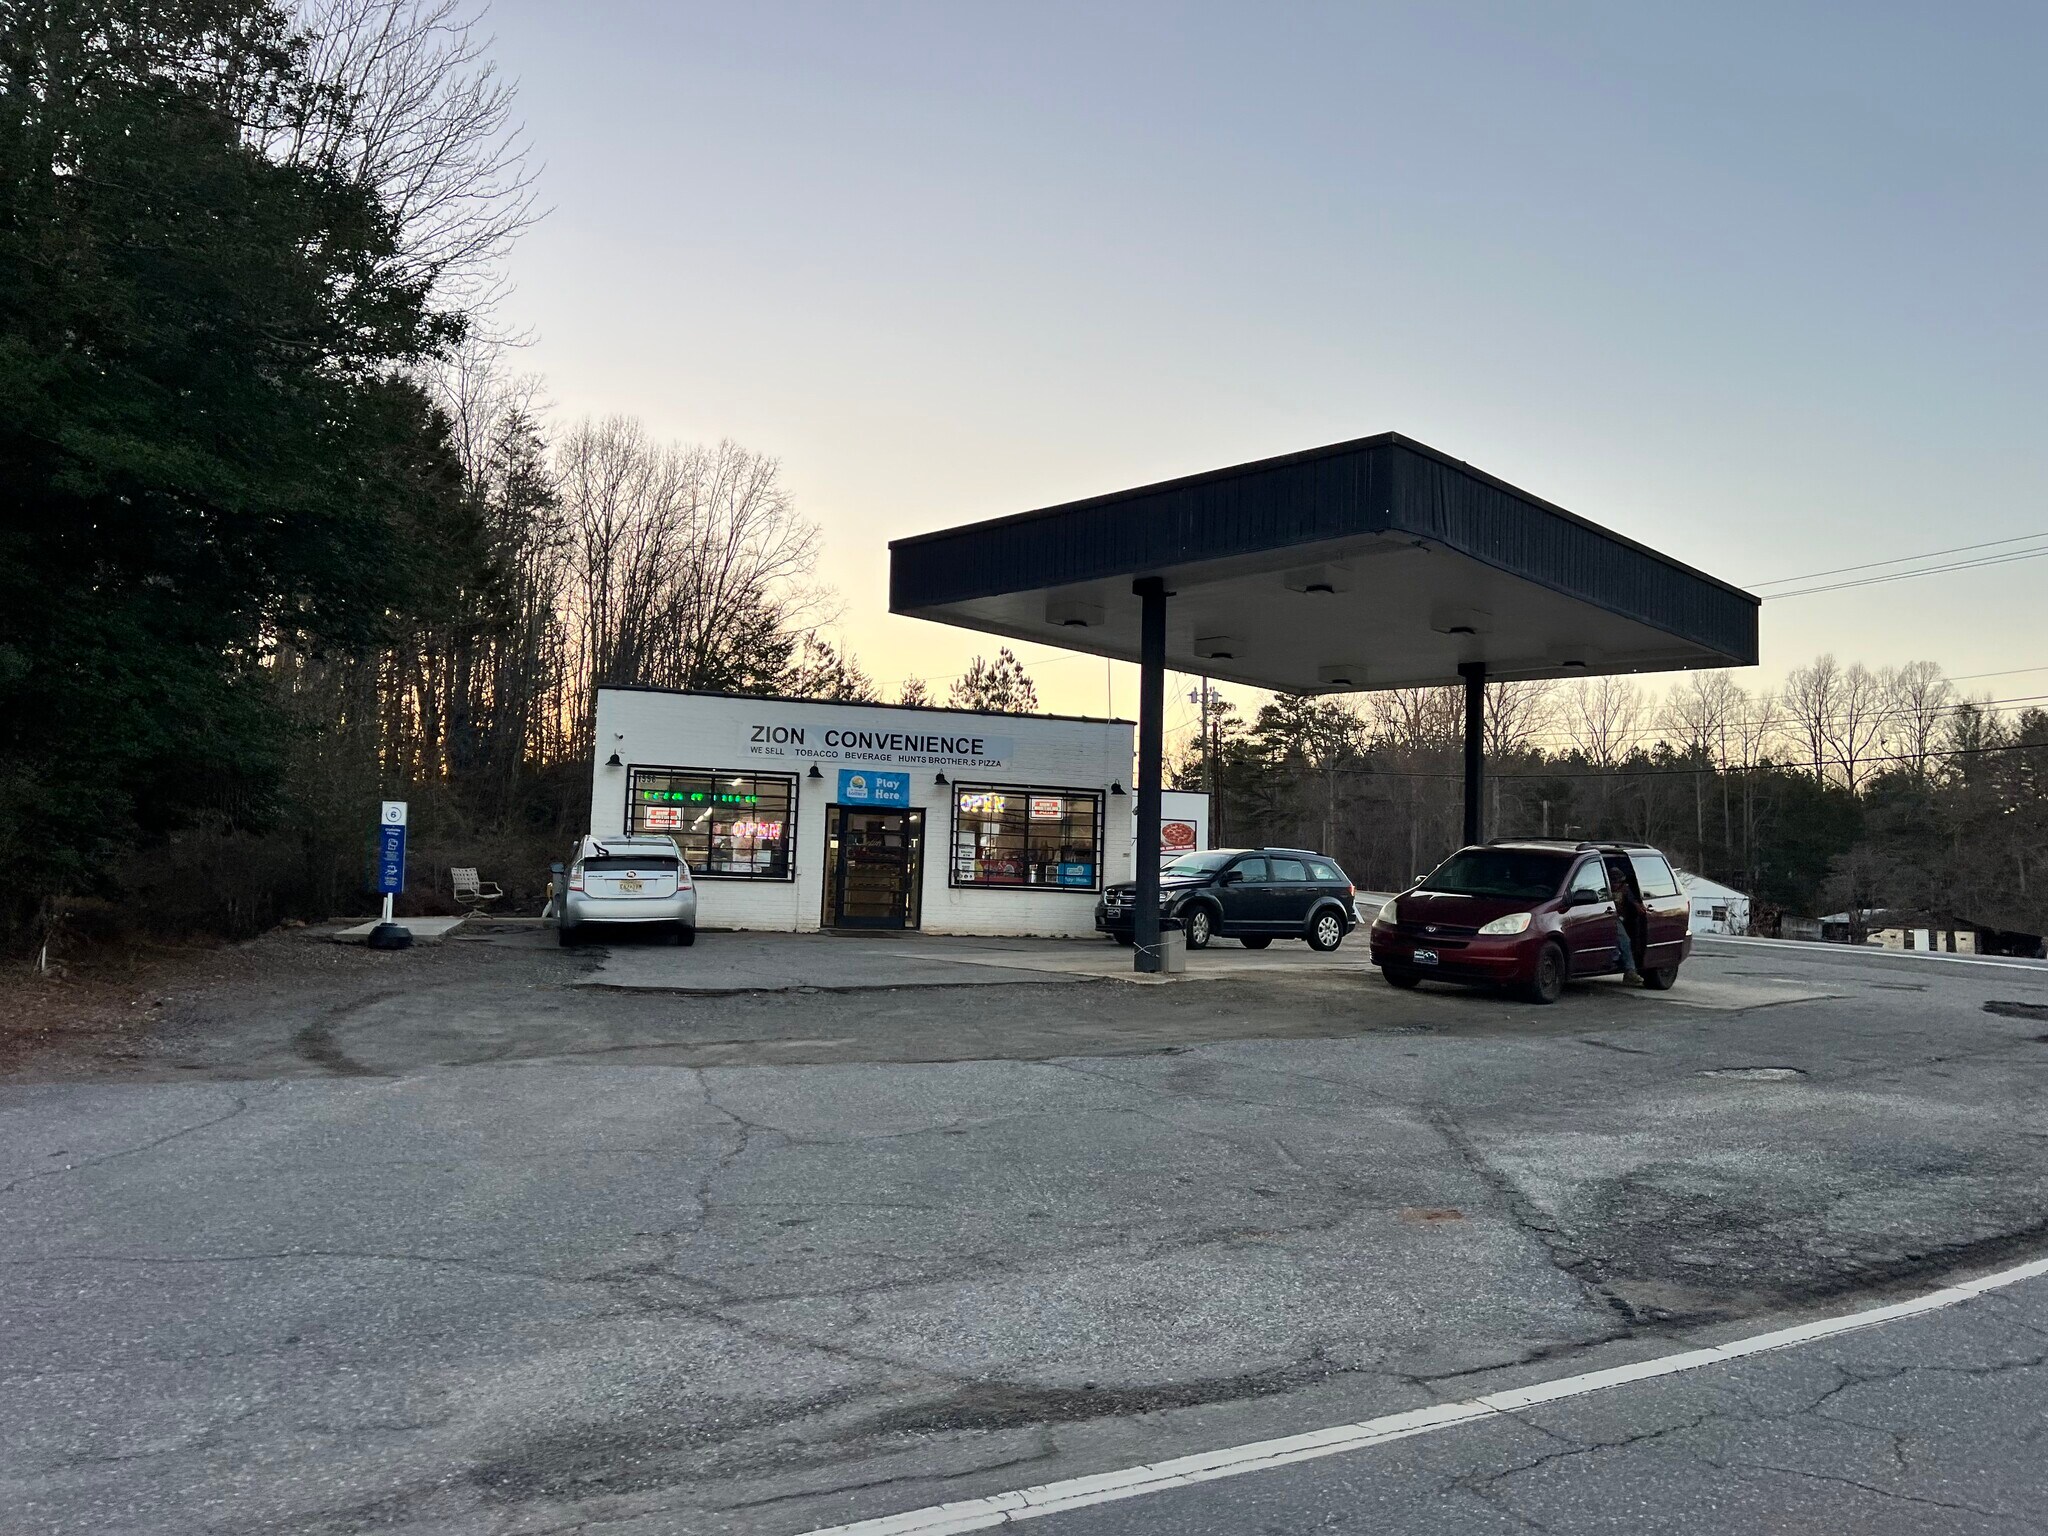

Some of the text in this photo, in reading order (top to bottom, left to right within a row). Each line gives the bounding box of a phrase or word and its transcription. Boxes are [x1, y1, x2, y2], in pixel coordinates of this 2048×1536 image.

[750, 725, 984, 755] ZION CONVENIENCE
[750, 746, 763, 754] WE
[765, 747, 785, 755] SELL
[795, 748, 839, 758] TOBACCO
[844, 751, 892, 761] BEVERAGE
[898, 755, 927, 764] HUNTS
[978, 759, 1002, 768] PIZZA
[876, 777, 900, 790] Play
[875, 789, 900, 800] Here
[960, 795, 1006, 813] OPEN
[732, 821, 782, 839] OPEN
